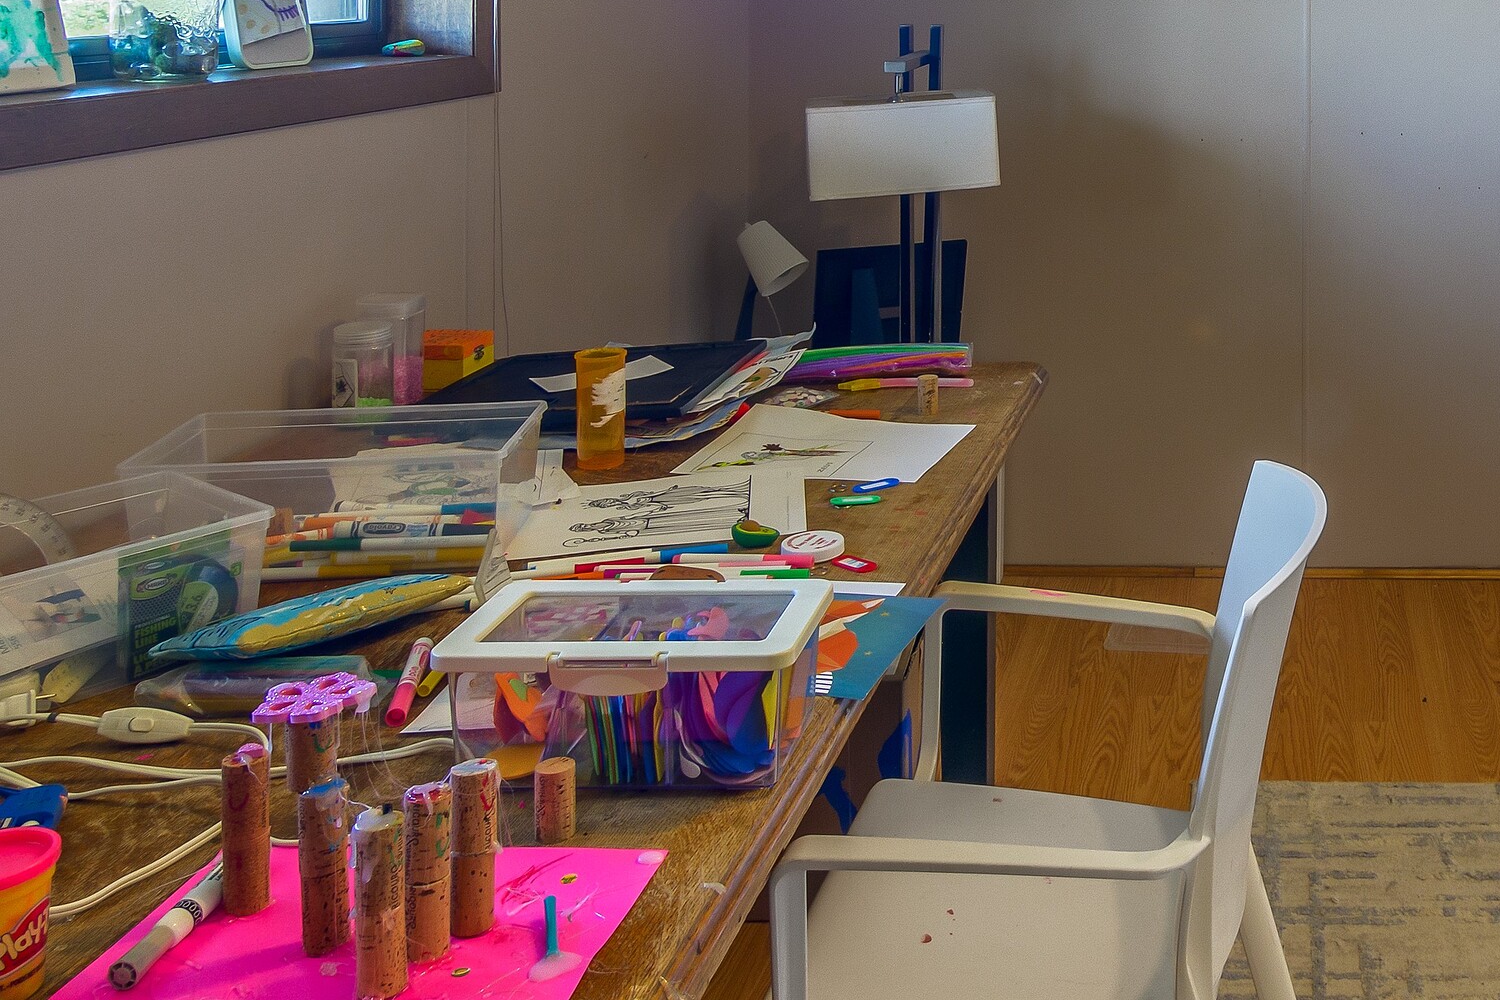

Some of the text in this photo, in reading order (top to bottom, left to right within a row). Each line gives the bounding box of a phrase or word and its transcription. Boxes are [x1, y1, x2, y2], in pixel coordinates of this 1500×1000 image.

[367, 523, 402, 533] Crayola
[134, 616, 177, 638] FISHING
[135, 633, 159, 649] LINE
